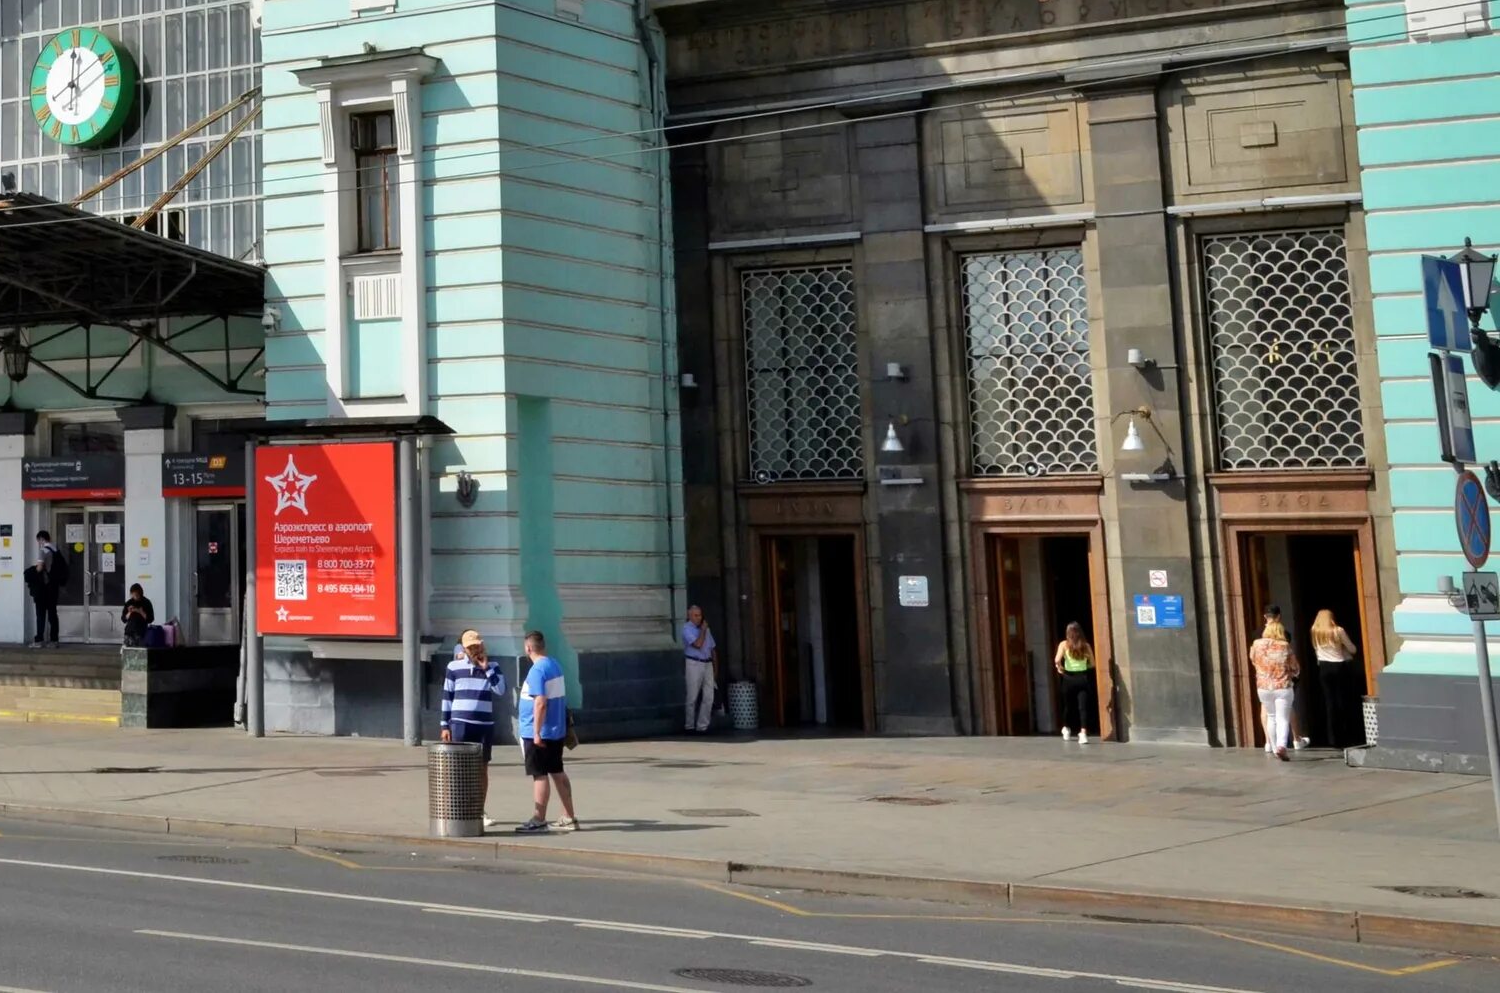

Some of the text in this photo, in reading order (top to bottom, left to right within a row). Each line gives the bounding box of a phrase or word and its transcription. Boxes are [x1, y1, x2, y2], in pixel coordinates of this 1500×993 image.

[173, 472, 203, 485] 13-15
[1259, 494, 1331, 507] ВХОД
[274, 522, 373, 533] Аэроэкспресс в аэропорт
[274, 534, 330, 546] Шереметьево
[324, 560, 337, 568] 800
[339, 560, 374, 568] 700-33-77
[324, 584, 338, 593] 495
